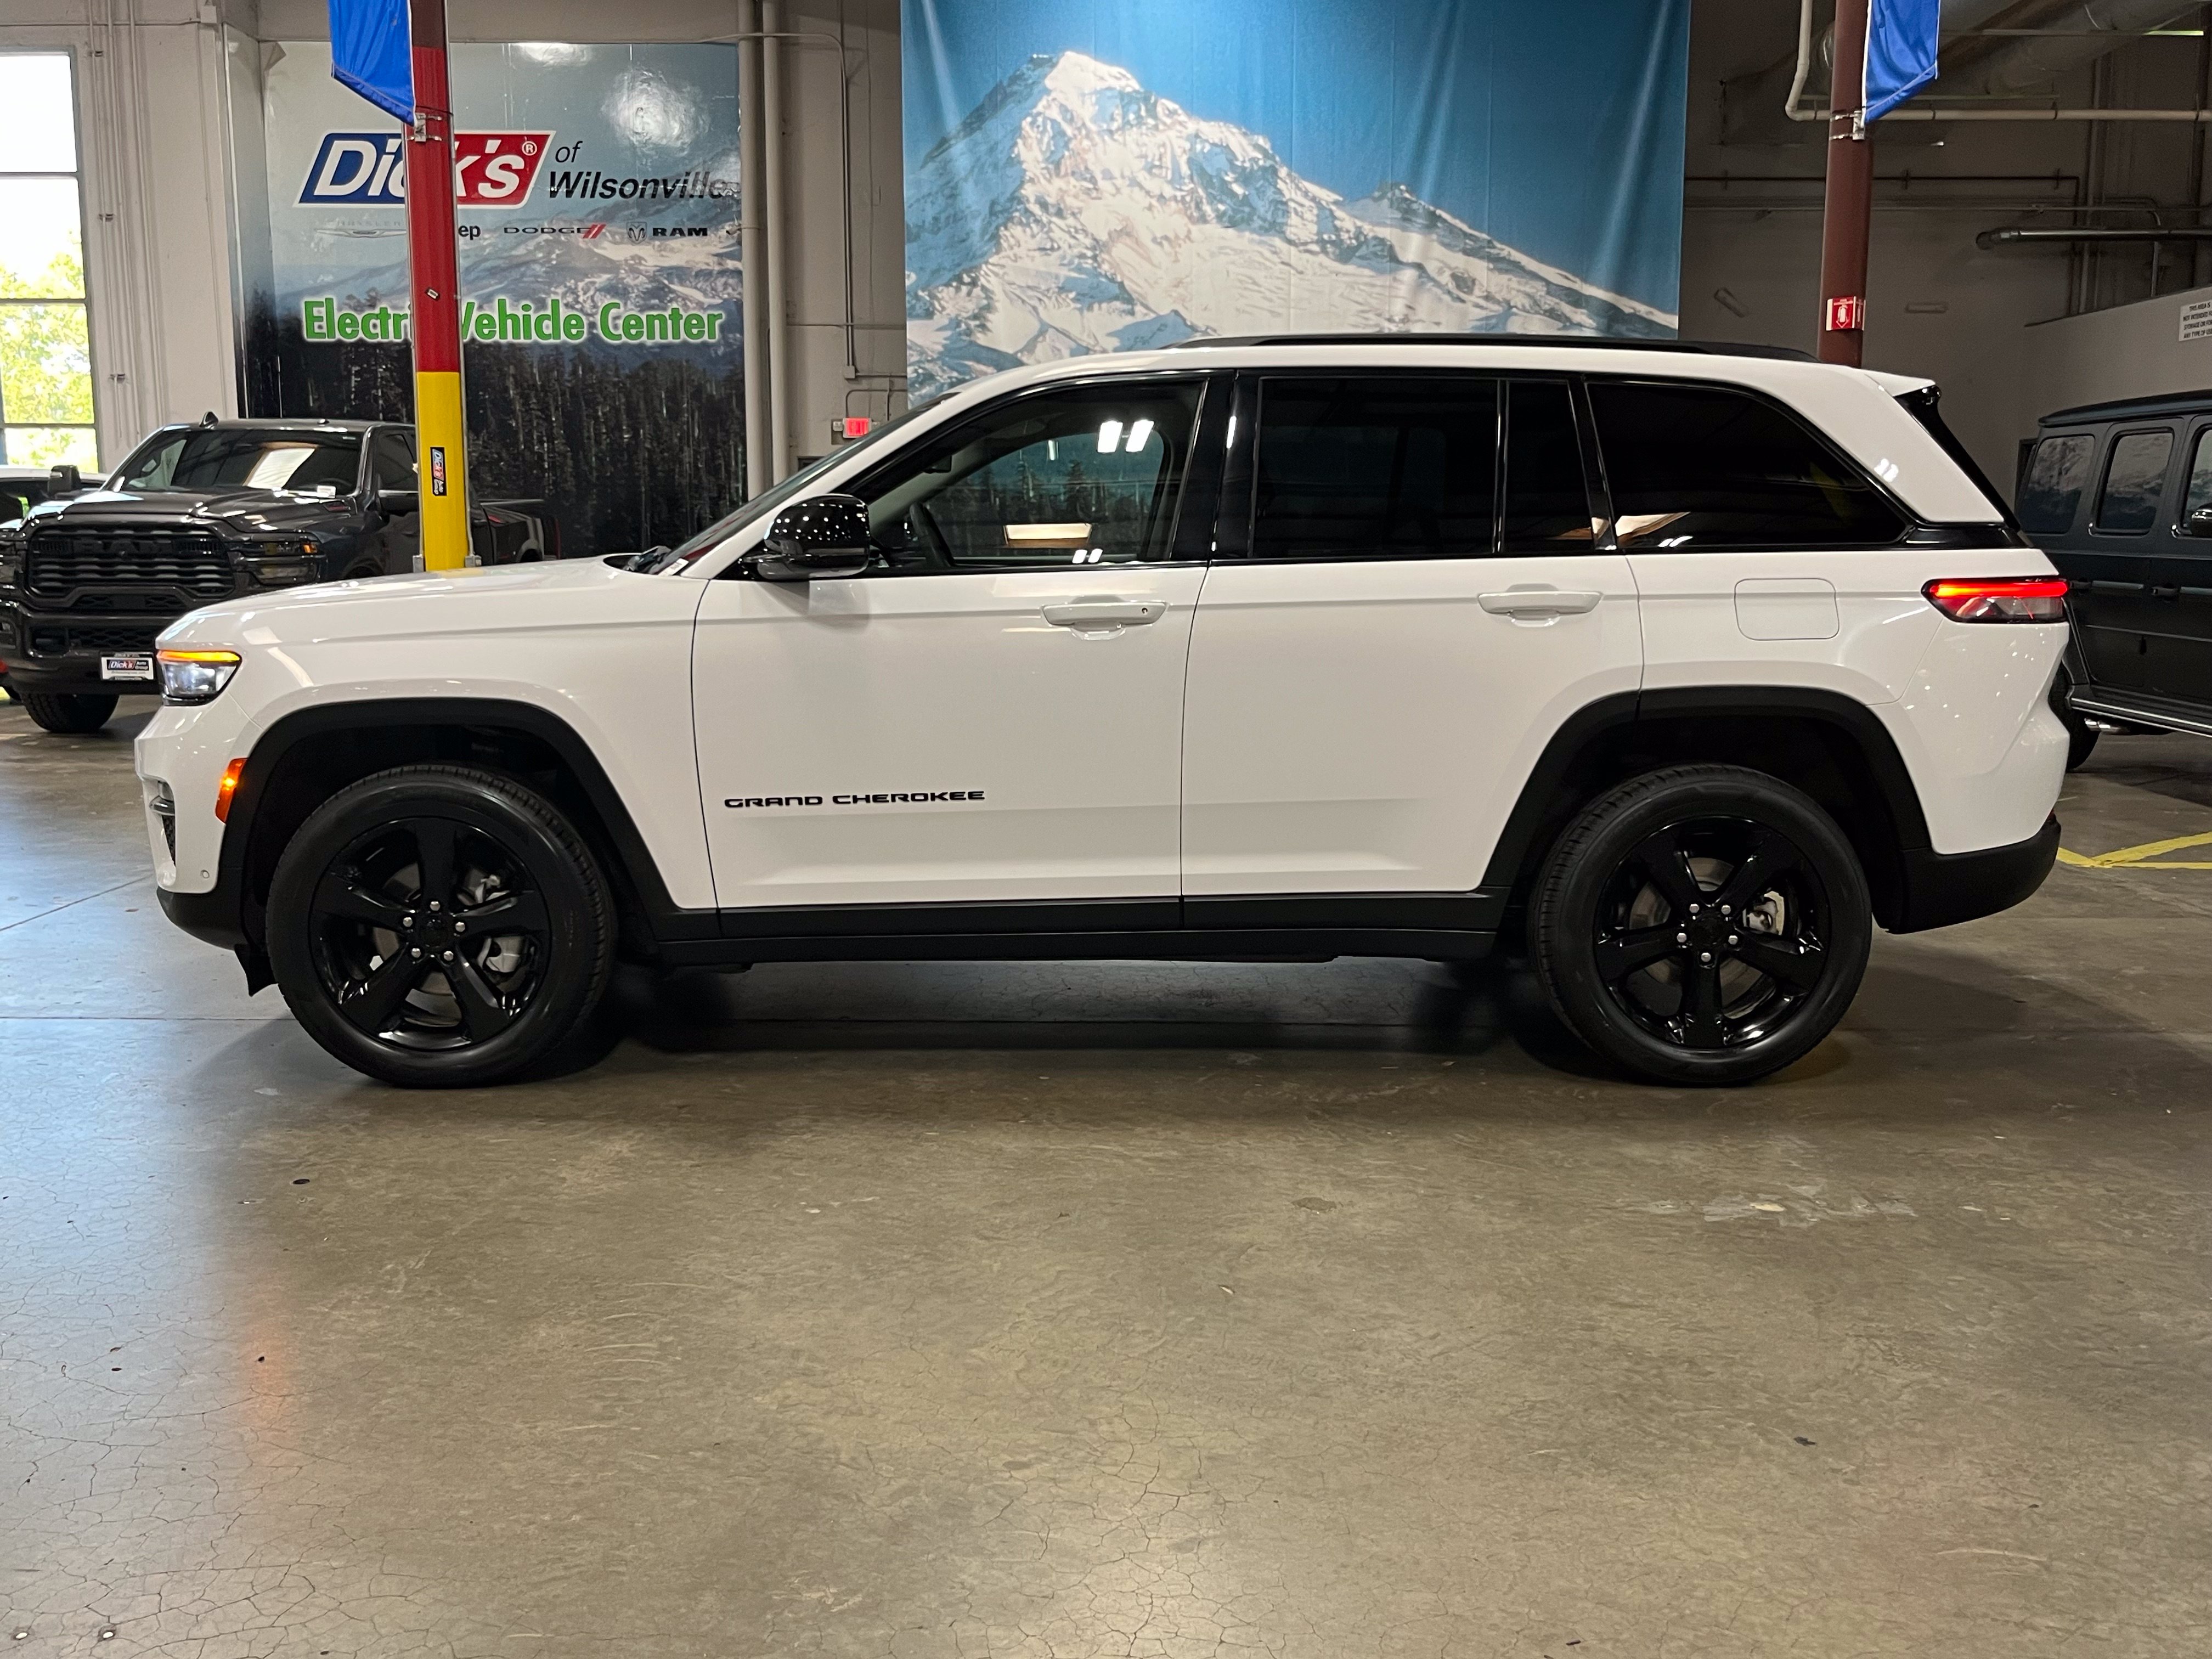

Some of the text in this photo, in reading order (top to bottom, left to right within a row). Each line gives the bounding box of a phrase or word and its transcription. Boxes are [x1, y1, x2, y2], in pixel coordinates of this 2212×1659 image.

[555, 141, 583, 163] of
[549, 171, 725, 199] Wilsonville
[653, 228, 708, 236] RAM
[600, 302, 723, 341] Center
[724, 791, 985, 808] GRAND CHEROKEE
